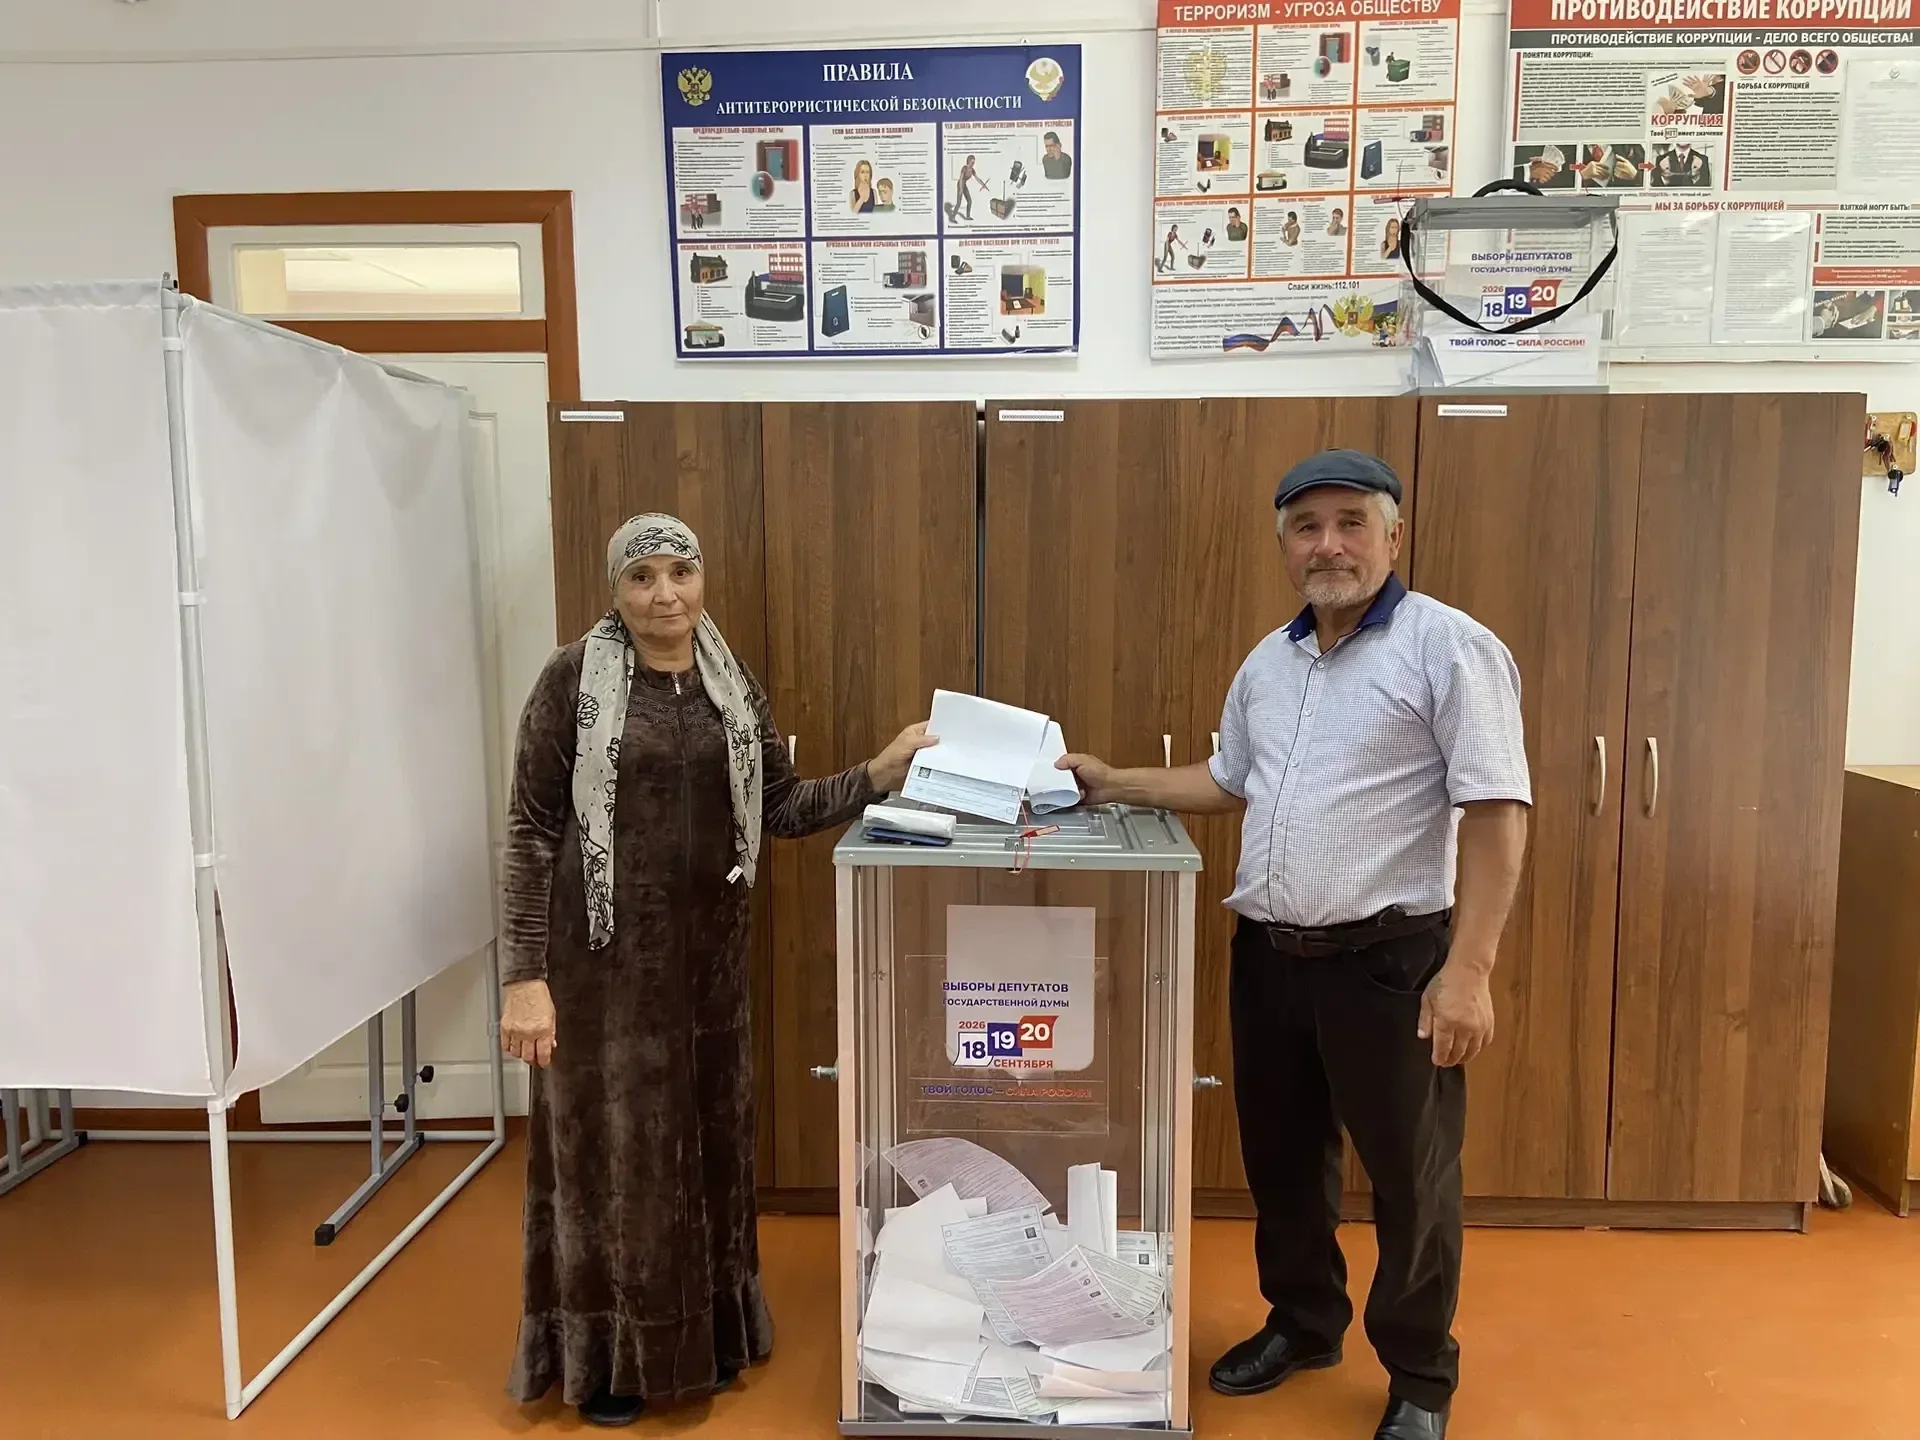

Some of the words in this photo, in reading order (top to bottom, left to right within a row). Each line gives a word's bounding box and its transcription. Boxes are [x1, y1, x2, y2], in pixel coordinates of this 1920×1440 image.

[1173, 3, 1270, 21] ТЕРРОРИЗМ
[1284, 2, 1346, 18] УГРОЗА
[1350, 0, 1442, 16] ОБЩЕСТВУ
[1551, 0, 1770, 24] ПРОТИВОДЕЙСТВИЕ
[1776, 0, 1911, 23] КОРРУПЦИИ
[1551, 31, 1673, 45] ПРОТИВОДЕЙСТВИЕ
[1676, 32, 1752, 45] КОРРУПЦИИ
[1763, 32, 1798, 44] ДЕЛО
[1801, 32, 1840, 43] ВСЕГО
[1842, 32, 1913, 44] ОБЩЕСТВА!
[1522, 51, 1552, 59] ПОНЯТИЕ
[1553, 51, 1594, 59] КОРРУПЦИИ:
[823, 62, 914, 82] ПРАВИЛА
[1768, 82, 1810, 90] КОРРУПЦИЕЙ
[716, 96, 899, 115] АНТИТЕРОРРИСТИЧЕСКОЙ
[1651, 114, 1724, 127] КОРРУПЦИЯ
[1655, 202, 1671, 211] МЫ
[1673, 202, 1684, 211] ЗА
[1685, 201, 1719, 211] БОРЬБУ
[1720, 202, 1727, 210] С
[1727, 200, 1785, 212] КОРРУПЦИЕЙ
[1840, 203, 1867, 211] ВЗЯТКОЙ
[1471, 252, 1514, 261] ВЫБОРЫ
[1515, 252, 1573, 261] ДЕПУТАТОВ
[1470, 265, 1547, 274] ГОСУДАРСТВЕННОЙ
[1548, 266, 1572, 274] ДУМЫ
[1288, 282, 1309, 291] Спаси
[1482, 285, 1504, 293] 2026
[1484, 303, 1503, 317] 18
[1508, 293, 1527, 309] 19
[1531, 285, 1555, 301] 20
[1450, 337, 1474, 346] ТВОЙ
[1476, 339, 1507, 347] ГОЛОС
[1516, 339, 1541, 347] СИЛА
[1544, 339, 1586, 347] РОССИИ!
[943, 982, 995, 992] ВЫБОРЫ
[998, 982, 1069, 993] ДЕПУТАТОВ
[943, 998, 1038, 1007] ГОСУДАРСТВЕННОЙ
[1039, 999, 1070, 1008] ДУМЫ
[959, 1021, 986, 1030] 2026
[962, 1041, 986, 1059] 18
[991, 1031, 1016, 1050] 19
[1020, 1022, 1051, 1041] 20
[993, 1059, 1053, 1069] СЕНТЯБРЯ
[921, 1083, 952, 1095] ТВОЙ
[955, 1085, 994, 1096] ГОЛОС
[1005, 1086, 1037, 1097] СИЛА
